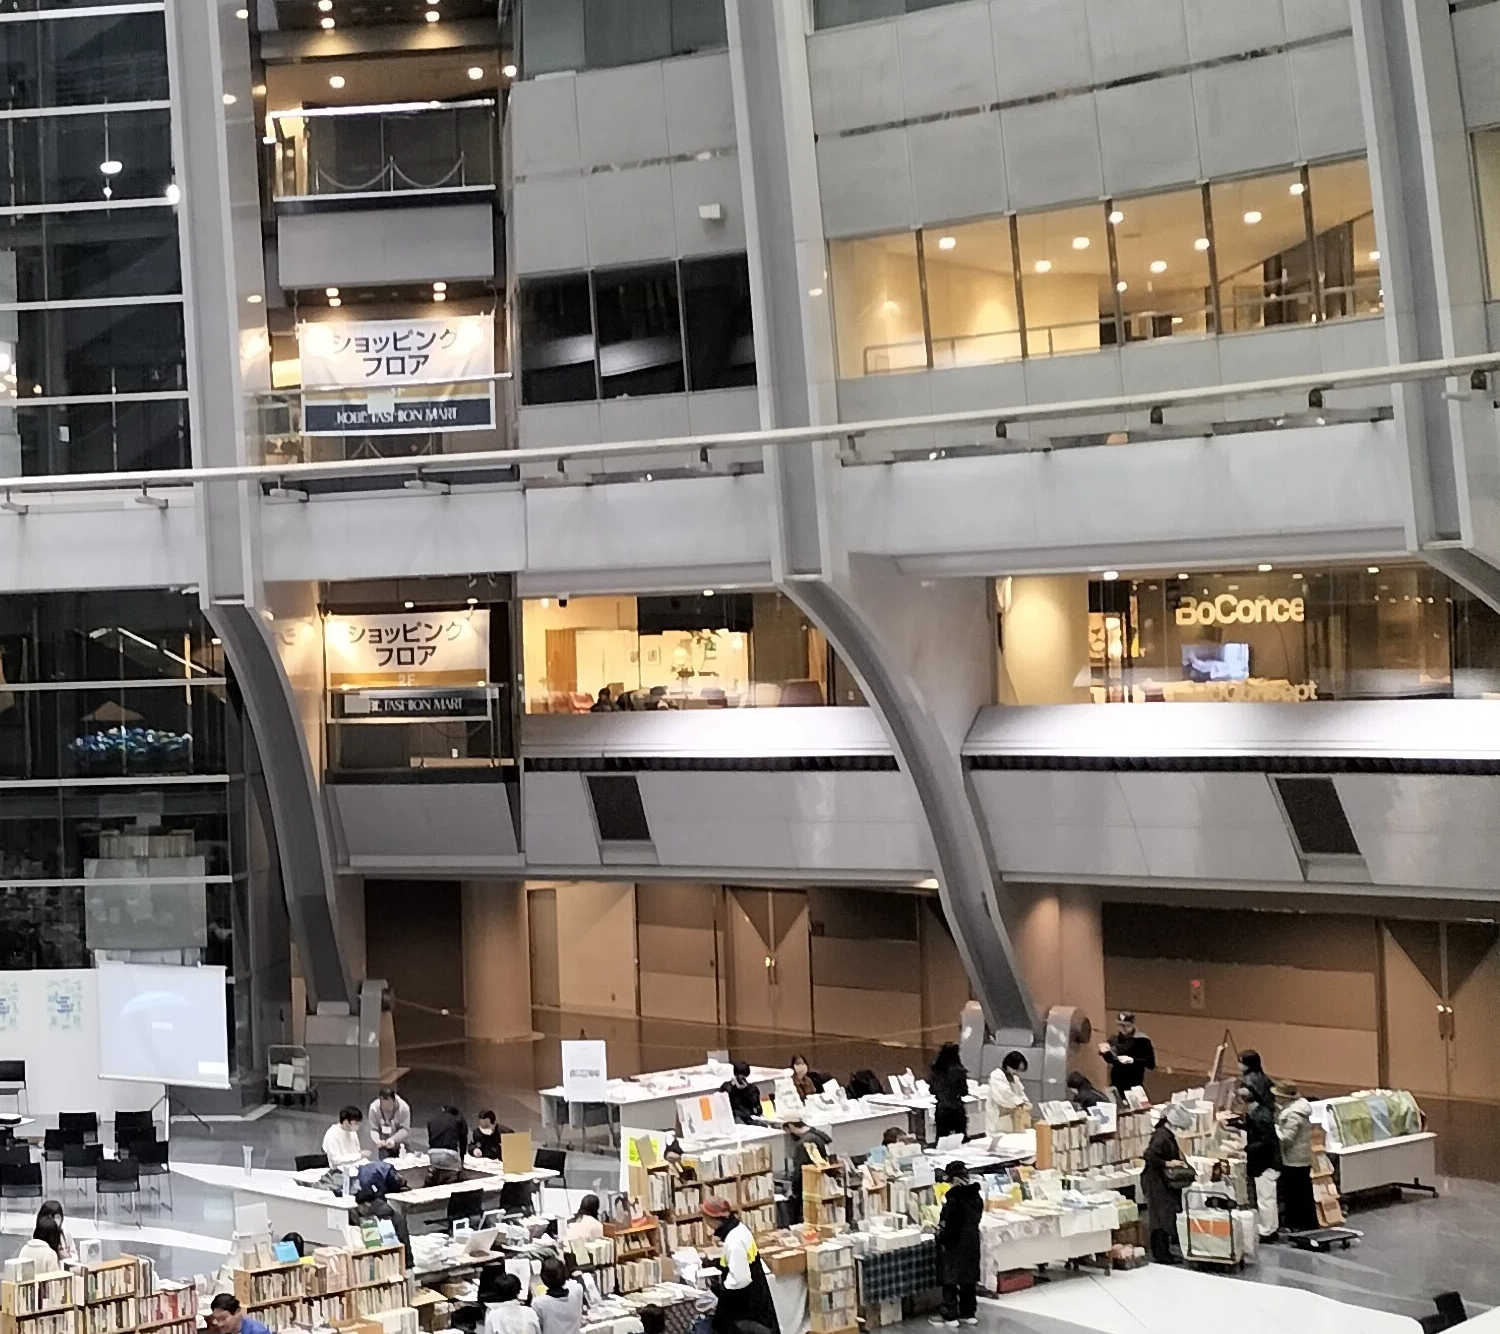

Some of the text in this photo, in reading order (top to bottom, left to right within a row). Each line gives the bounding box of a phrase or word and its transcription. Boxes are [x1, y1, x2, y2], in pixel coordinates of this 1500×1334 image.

[363, 355, 430, 377] フロア
[425, 407, 458, 421] MART
[376, 645, 437, 667] フロア
[397, 674, 416, 687] 2F
[433, 698, 463, 710] MART
